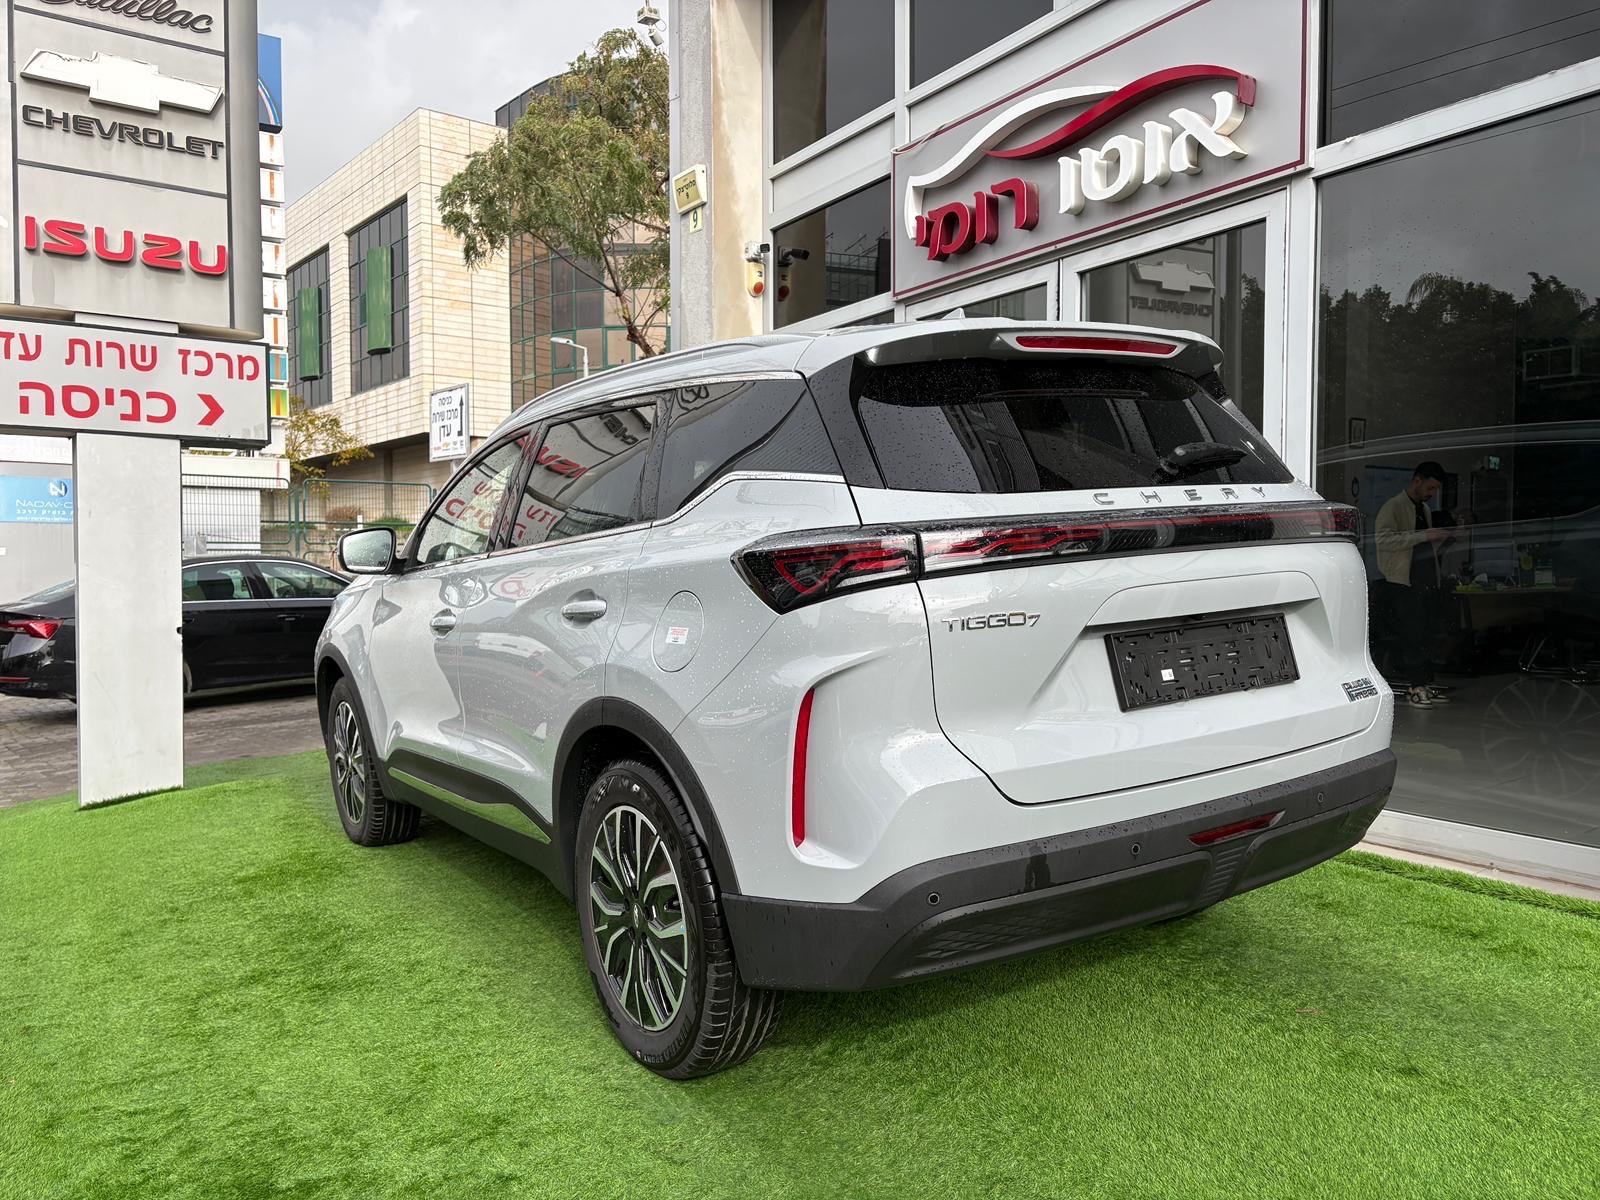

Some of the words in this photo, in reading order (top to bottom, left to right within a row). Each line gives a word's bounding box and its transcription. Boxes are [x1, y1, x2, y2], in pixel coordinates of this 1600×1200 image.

[22, 104, 224, 159] CHEVROLET
[1057, 90, 1249, 216] אוטו
[692, 209, 698, 229] 9
[915, 177, 1040, 261] רומי
[24, 216, 227, 275] ISUZU
[65, 338, 158, 372] שרות
[178, 349, 260, 382] מרכז
[19, 381, 177, 424] כניסה
[439, 424, 452, 442] עדן
[1092, 486, 1266, 506] CHERY
